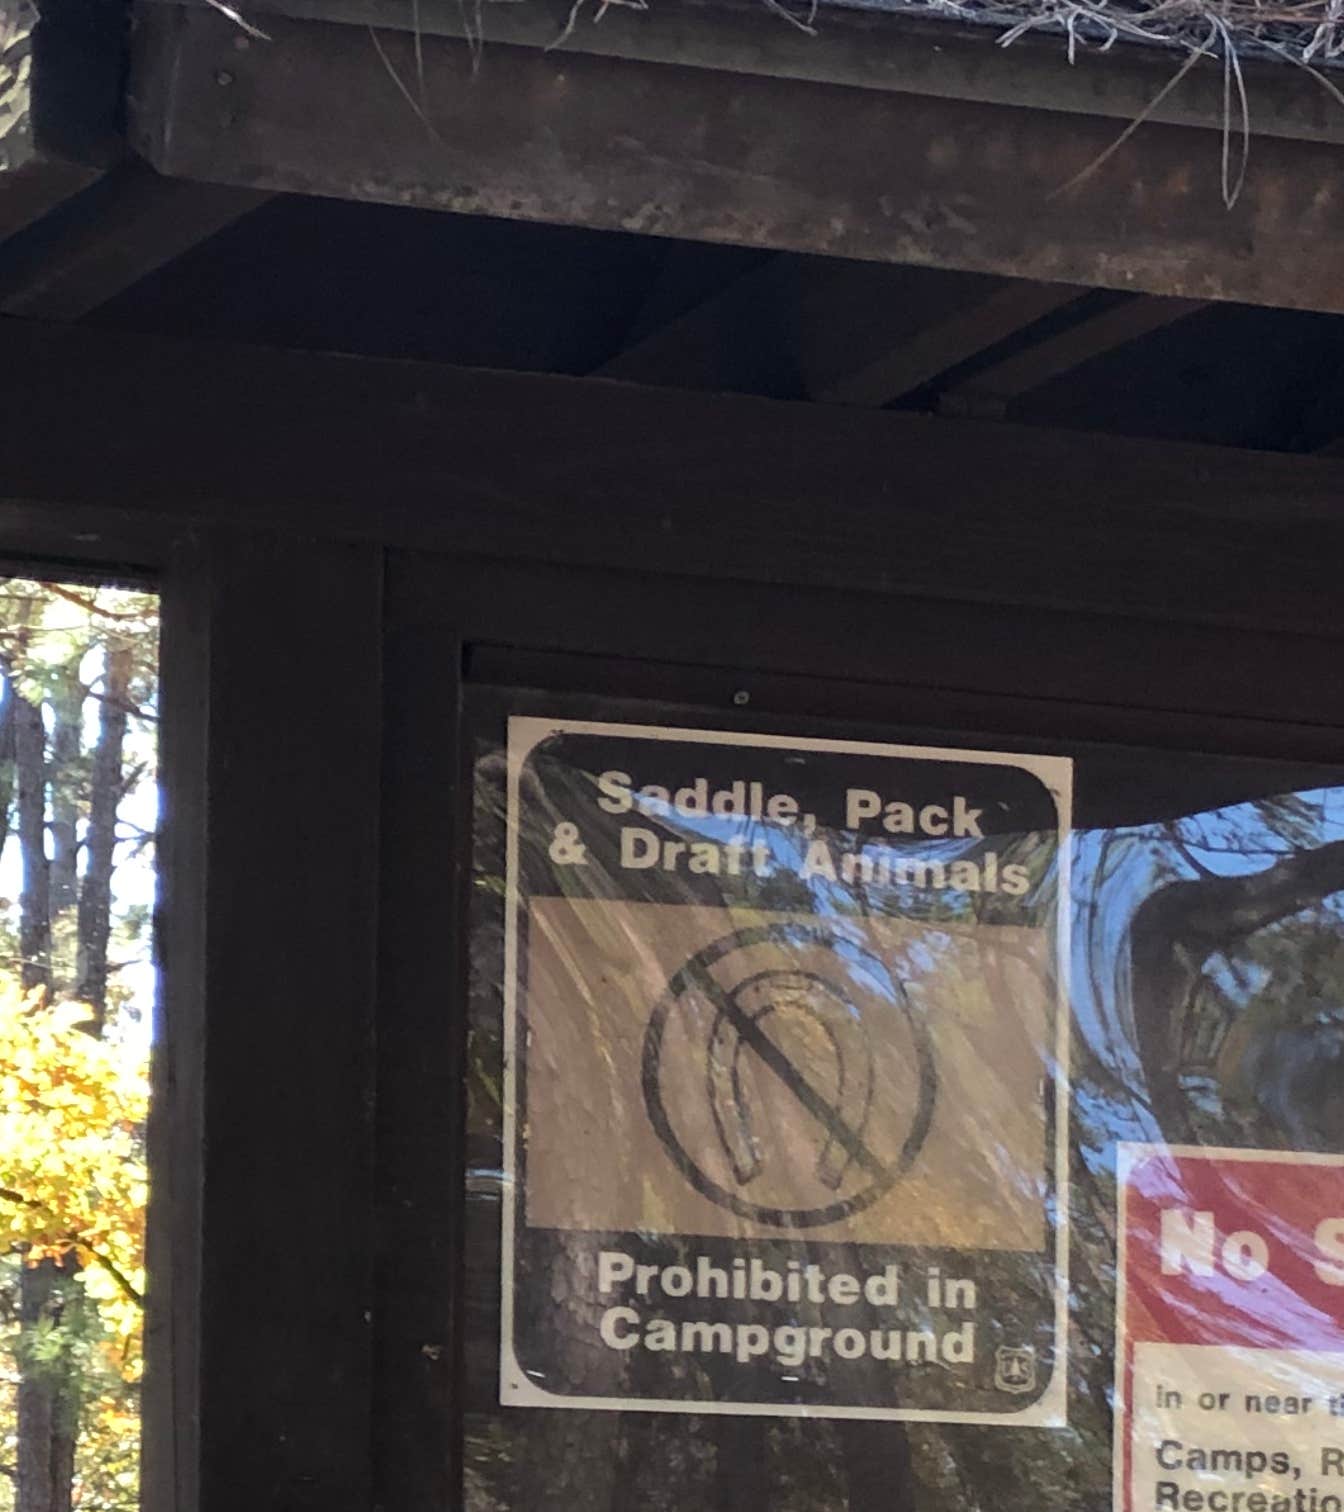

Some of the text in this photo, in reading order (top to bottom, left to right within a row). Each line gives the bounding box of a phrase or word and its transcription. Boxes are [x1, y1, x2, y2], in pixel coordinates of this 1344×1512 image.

[597, 770, 983, 839] Saddle, Pack
[548, 822, 1030, 896] & Draft Animals
[1160, 1209, 1269, 1281] No
[598, 1250, 976, 1309] Prohibited in
[600, 1307, 976, 1365] Campground
[1196, 1391, 1230, 1413] or
[1245, 1390, 1313, 1416] near
[1155, 1440, 1302, 1480] Camps,
